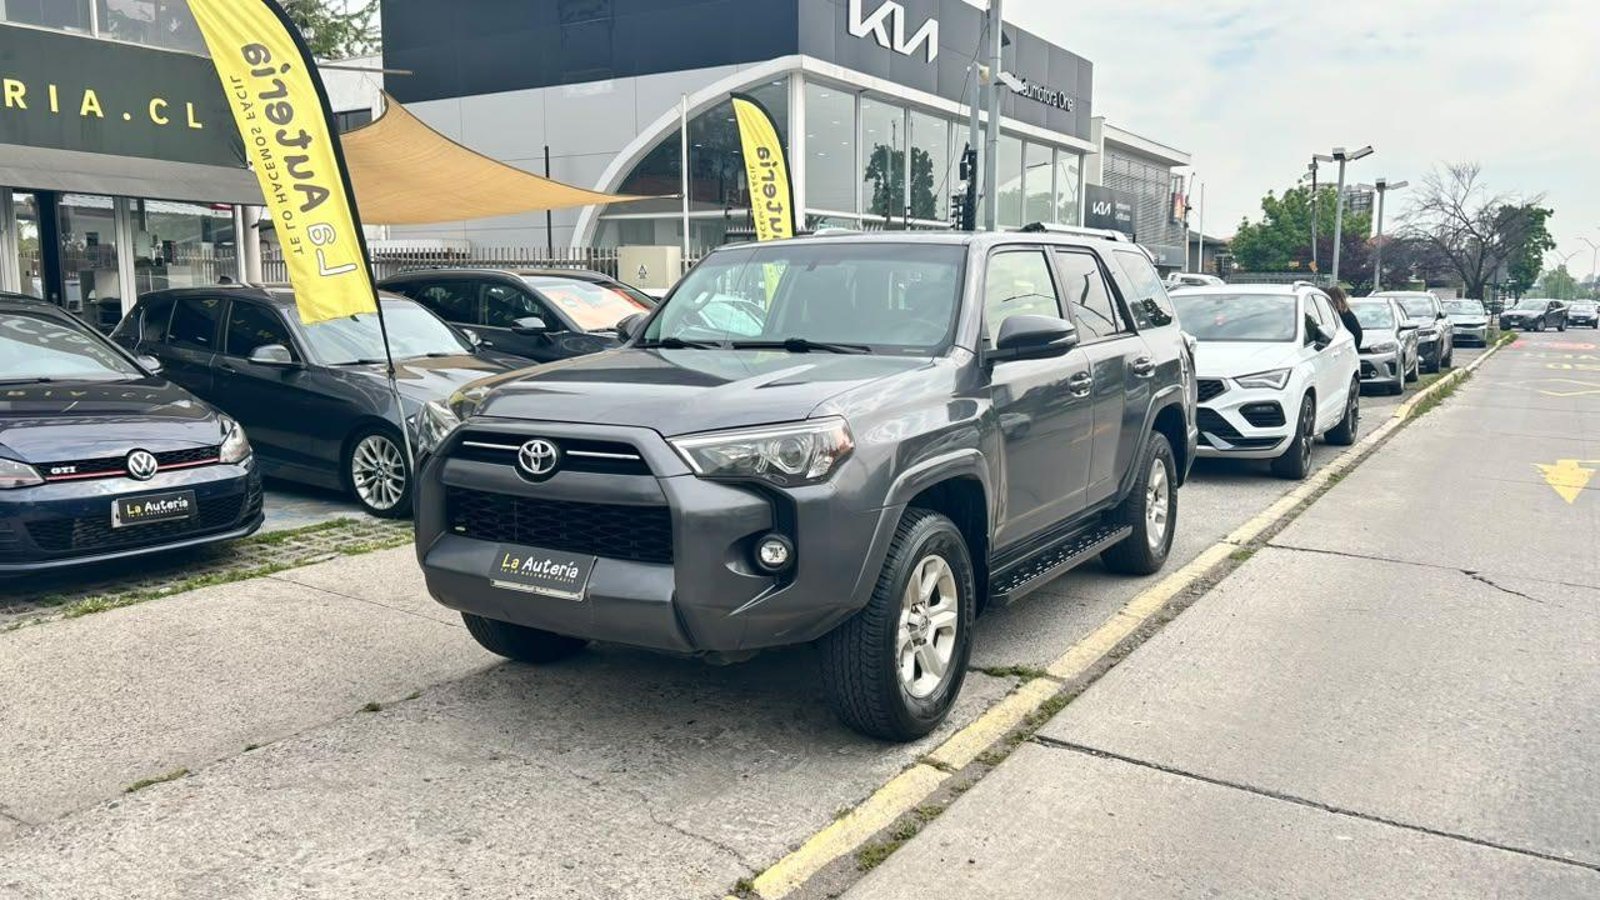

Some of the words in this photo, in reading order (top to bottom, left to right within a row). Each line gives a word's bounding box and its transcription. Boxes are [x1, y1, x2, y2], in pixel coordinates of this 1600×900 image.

[1059, 91, 1074, 112] One
[50, 465, 76, 475] GTI
[126, 504, 141, 515] La
[502, 553, 520, 569] La
[522, 556, 579, 578] Autería
